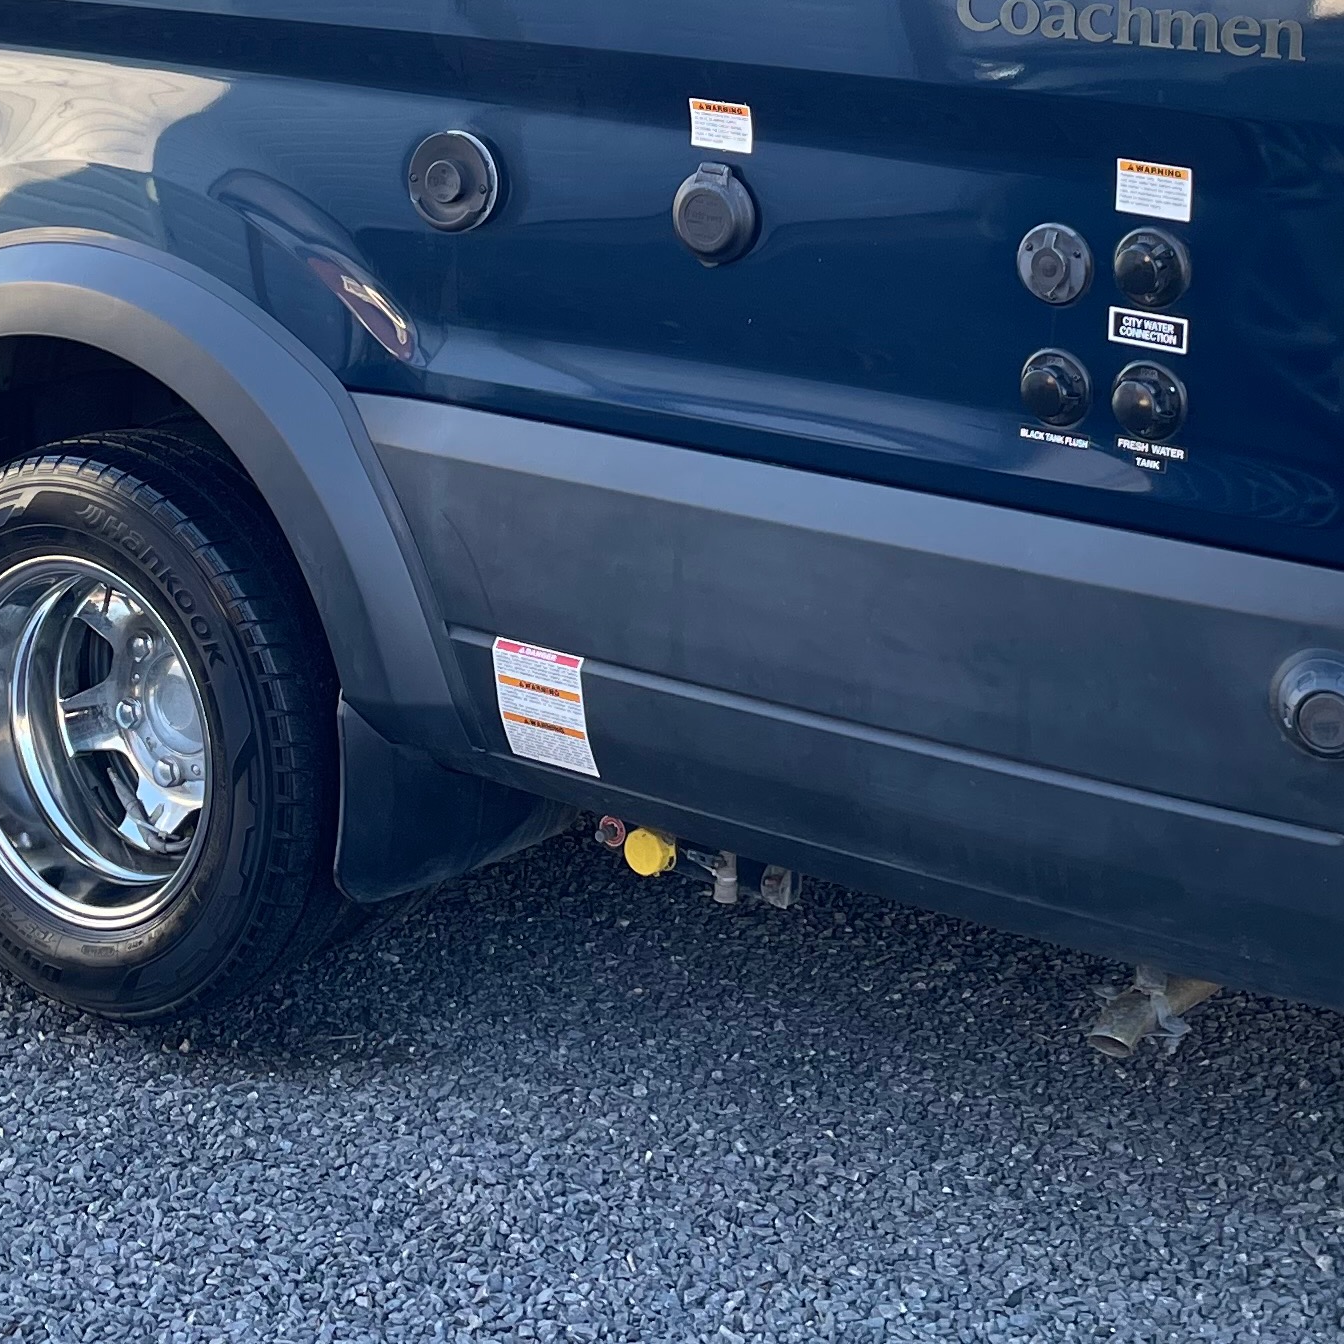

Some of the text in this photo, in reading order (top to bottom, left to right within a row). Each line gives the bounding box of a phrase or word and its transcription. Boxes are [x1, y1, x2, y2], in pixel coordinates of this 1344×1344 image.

[1135, 164, 1182, 178] WARNING
[1122, 316, 1175, 334] CITY WATER
[1119, 325, 1177, 345] CONNECTION
[1020, 428, 1089, 449] BLACK TANK FLUSH
[1117, 438, 1185, 460] FRESH WATER
[1135, 457, 1160, 470] TANK
